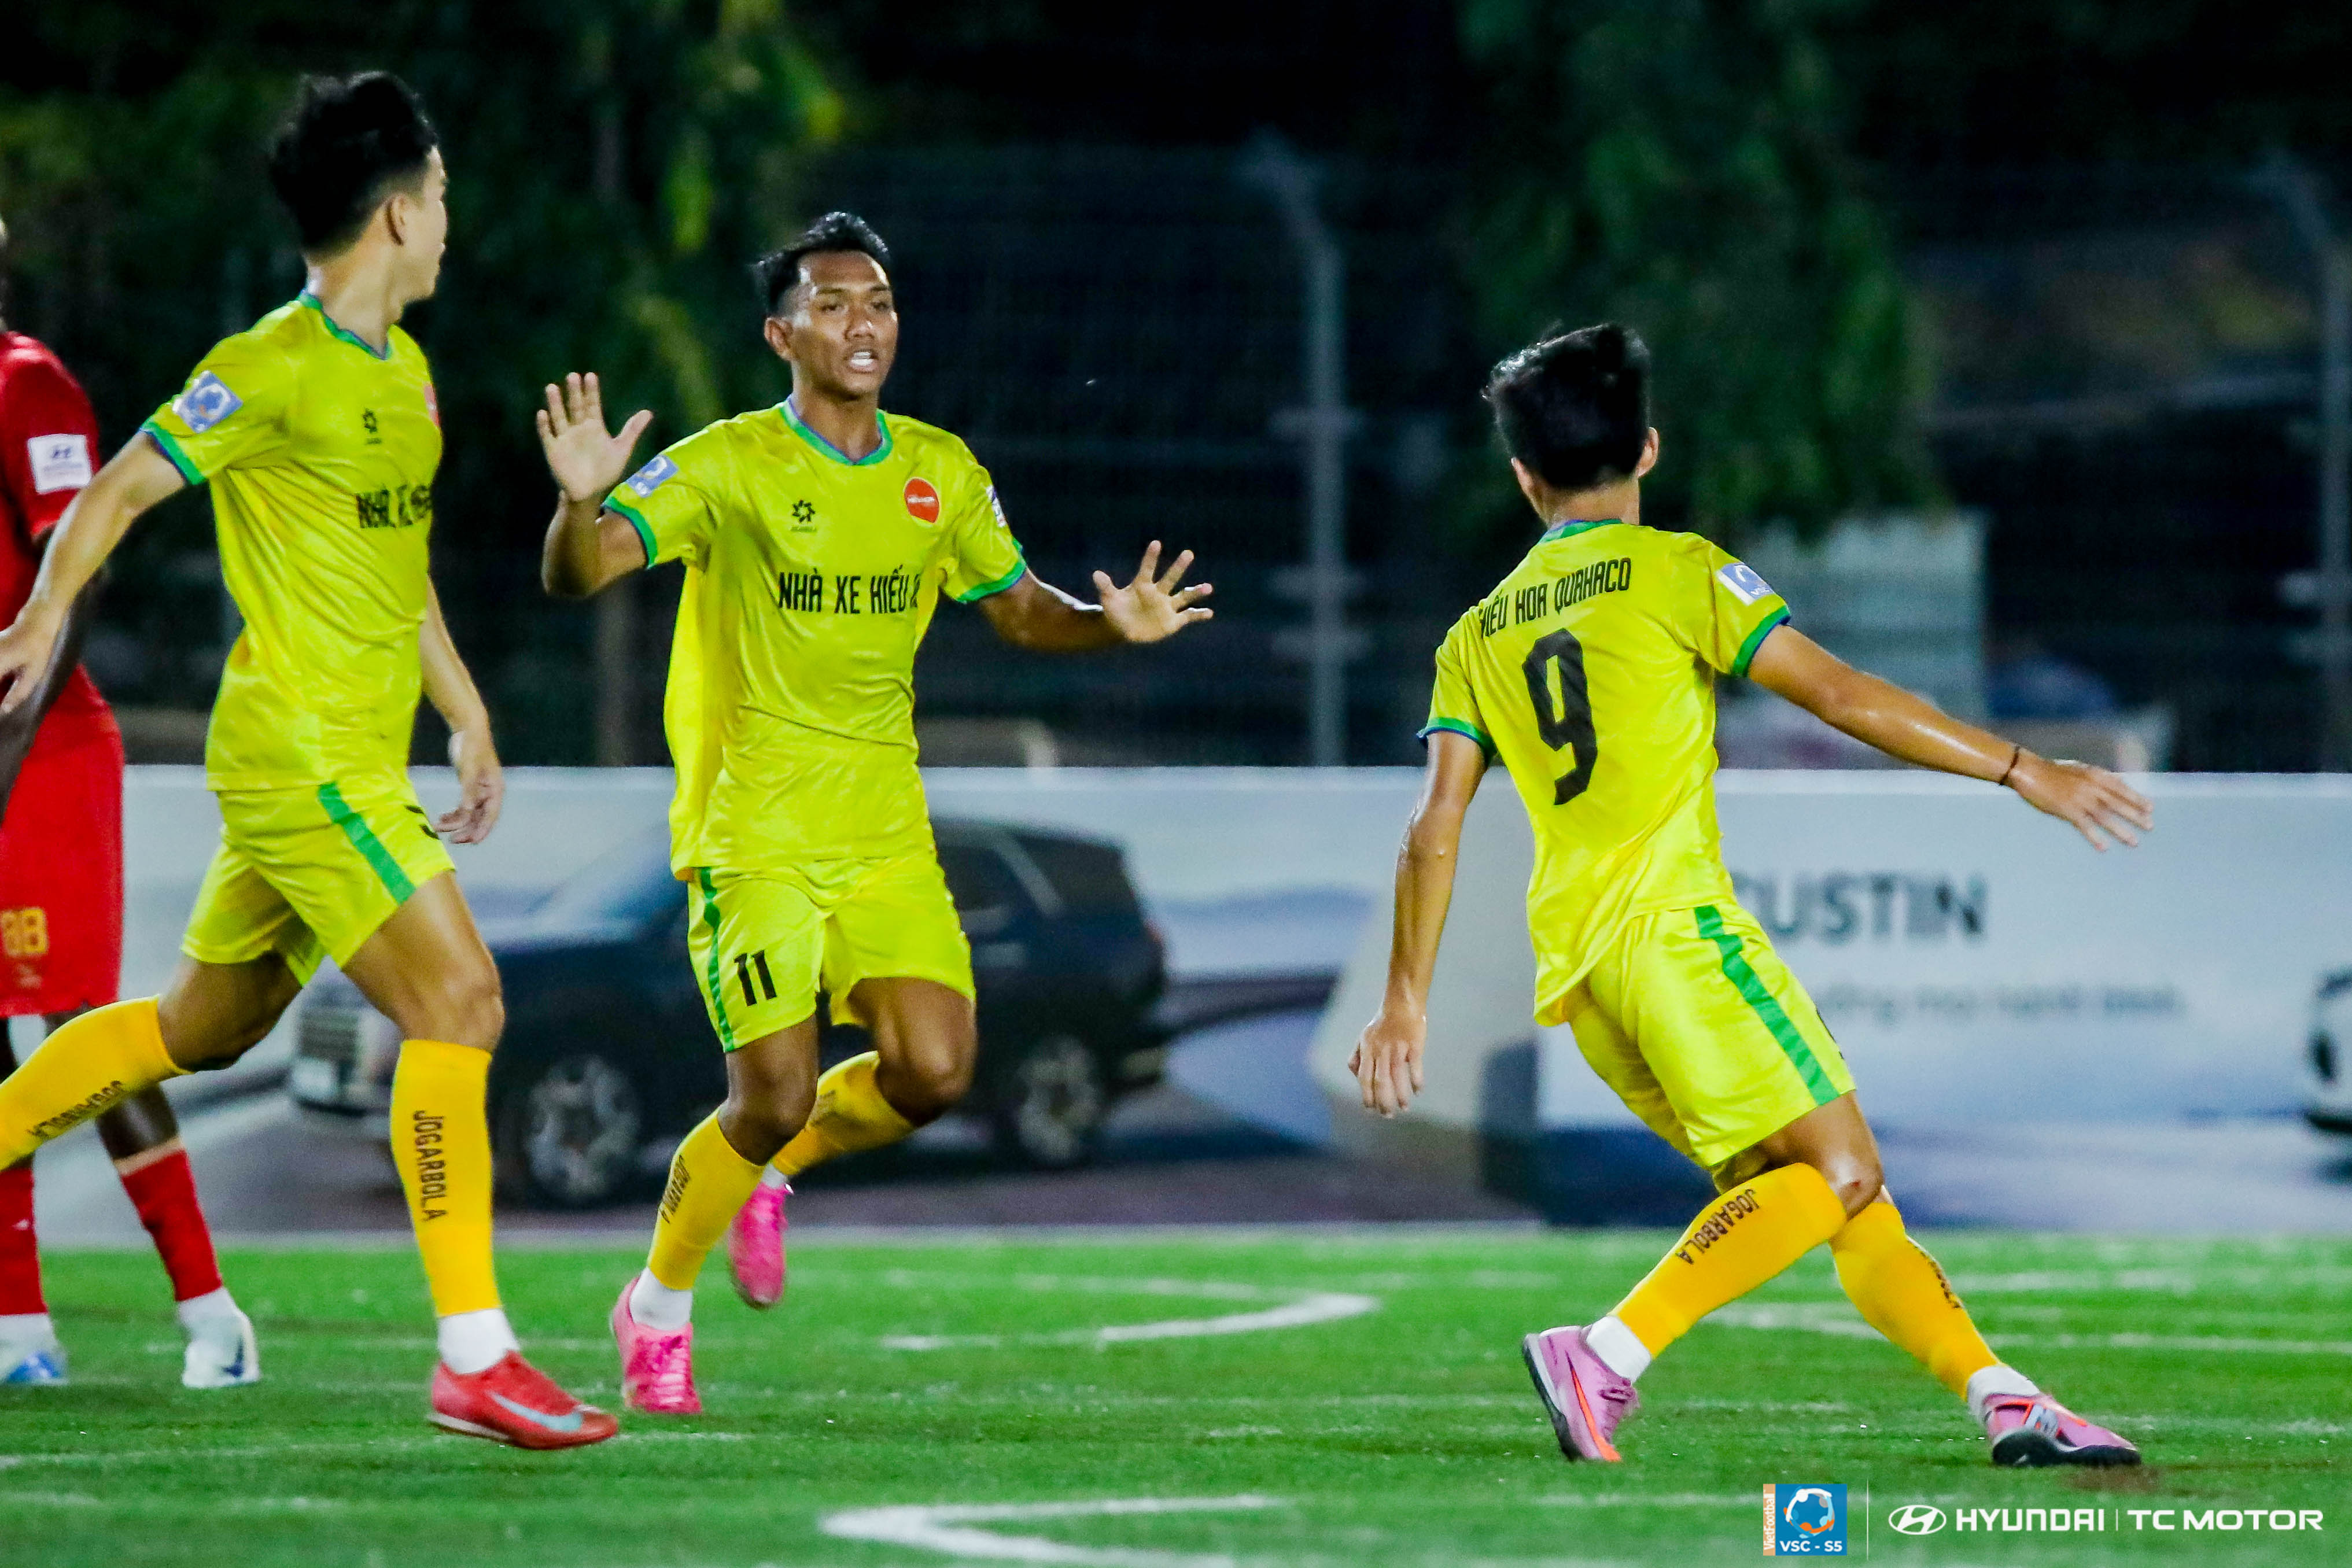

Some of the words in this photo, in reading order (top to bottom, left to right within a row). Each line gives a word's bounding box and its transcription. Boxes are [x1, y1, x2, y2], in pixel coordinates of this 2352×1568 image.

[779, 567, 824, 613] NHÀ
[834, 575, 861, 614] XE
[871, 563, 910, 614] HIẾU
[1515, 583, 1549, 625] HOA
[1554, 557, 1632, 615] QUAHACO
[1522, 628, 1598, 806] 9
[734, 950, 777, 1007] 11
[412, 1109, 448, 1223] JOGARBOLA
[1675, 1189, 1760, 1265] JOGARBOLA
